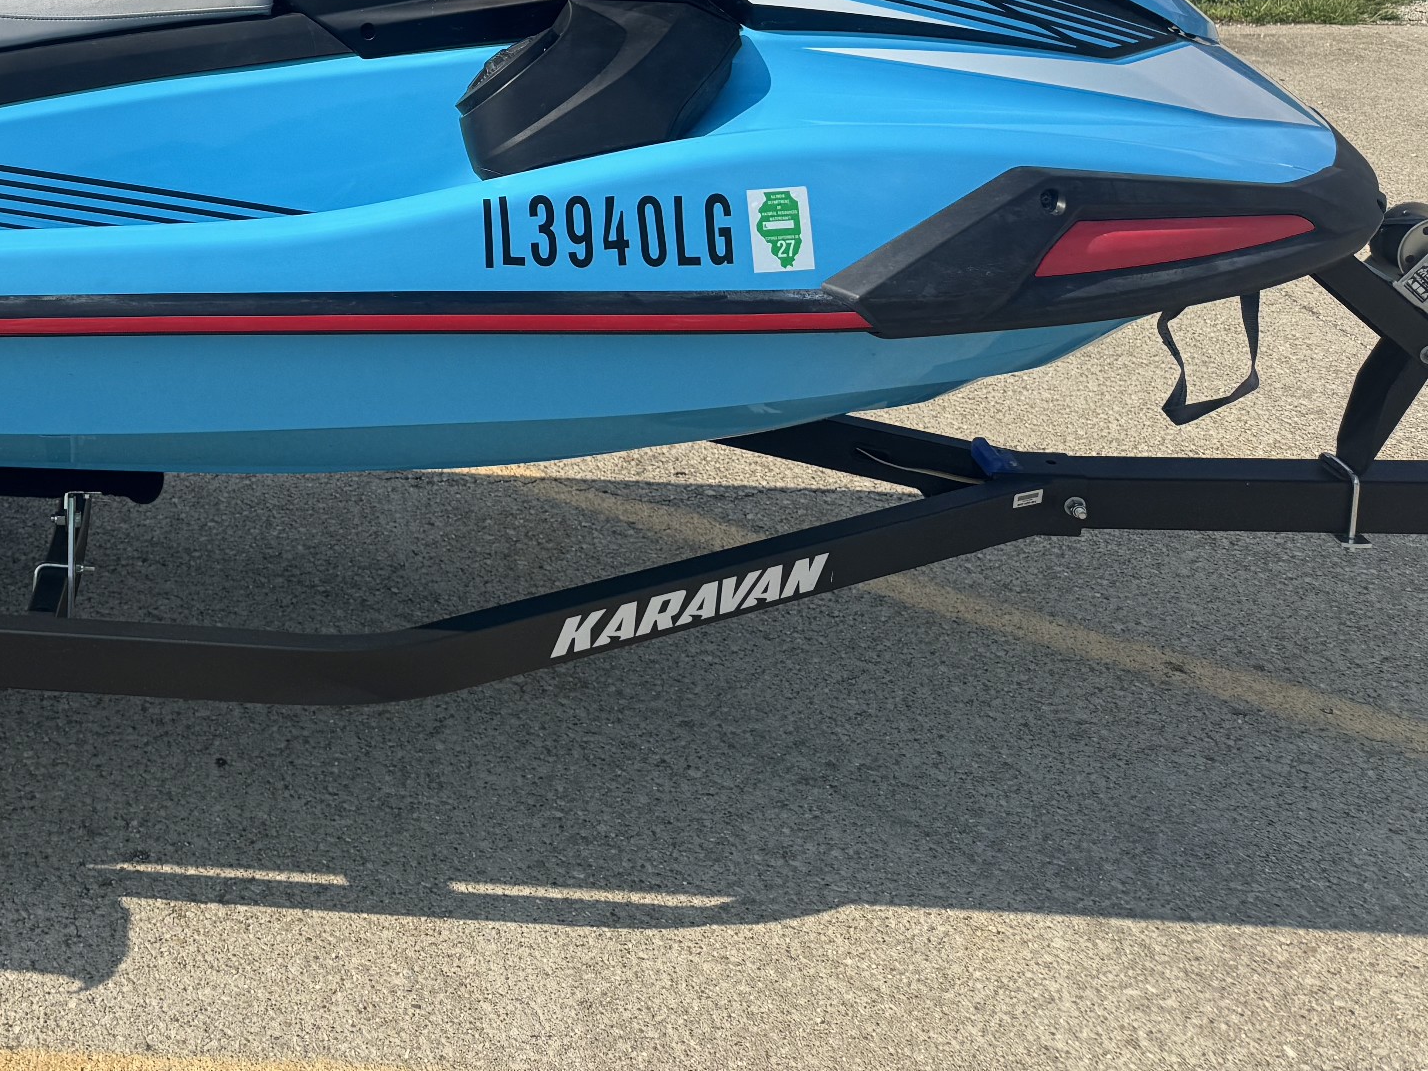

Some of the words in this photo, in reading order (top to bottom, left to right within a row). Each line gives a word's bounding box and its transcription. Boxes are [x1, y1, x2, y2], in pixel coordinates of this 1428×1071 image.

[482, 192, 734, 269] IL3940LG
[776, 239, 796, 258] 27
[550, 552, 830, 659] KARAVAN
